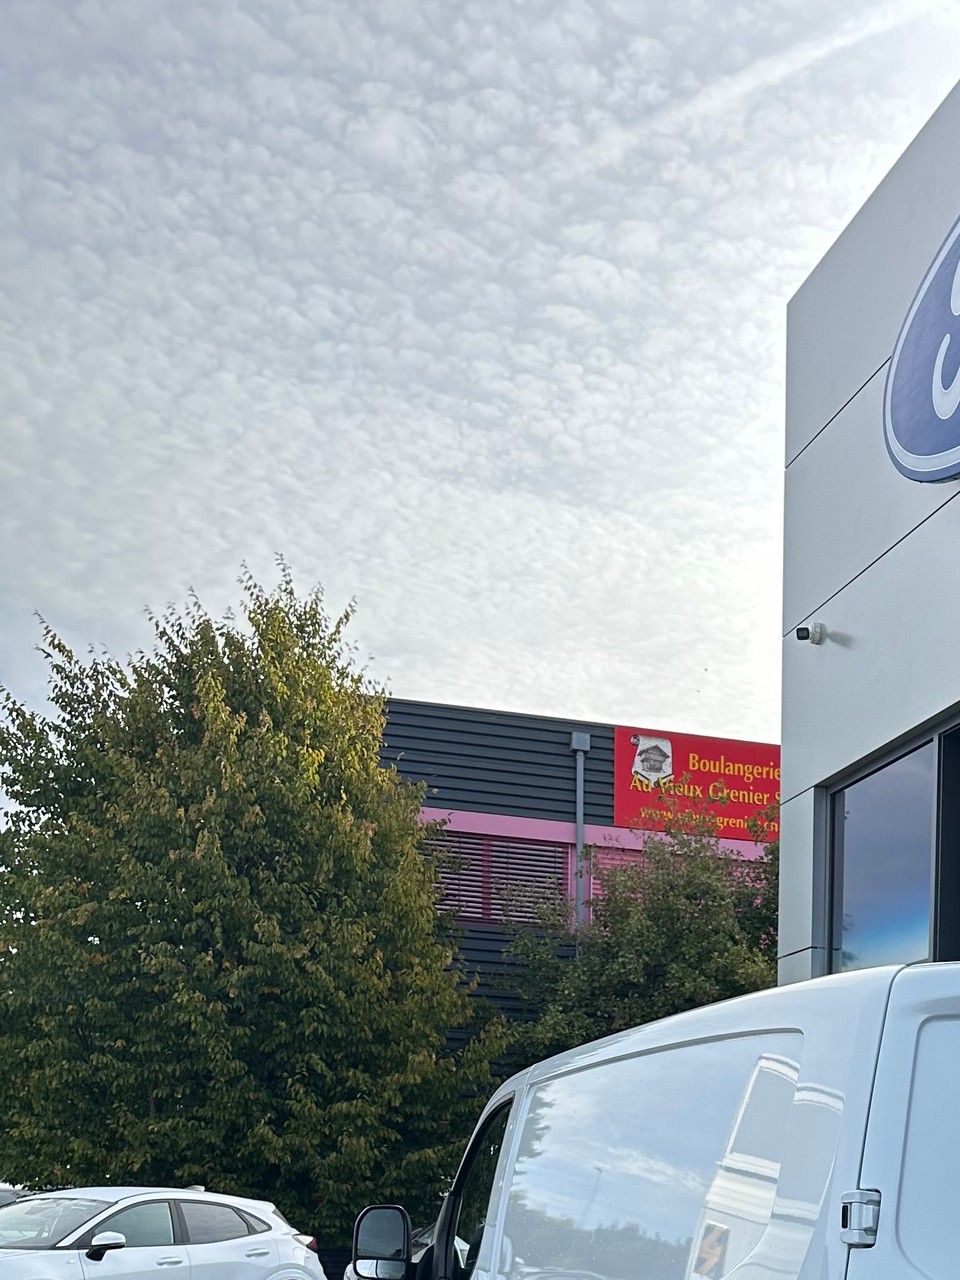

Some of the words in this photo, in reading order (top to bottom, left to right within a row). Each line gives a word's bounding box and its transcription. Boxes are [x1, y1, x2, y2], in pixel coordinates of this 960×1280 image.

[688, 752, 780, 782] Boulangerie
[629, 774, 652, 793] Au
[658, 776, 703, 798] Vieux
[708, 782, 769, 805] Grenier
